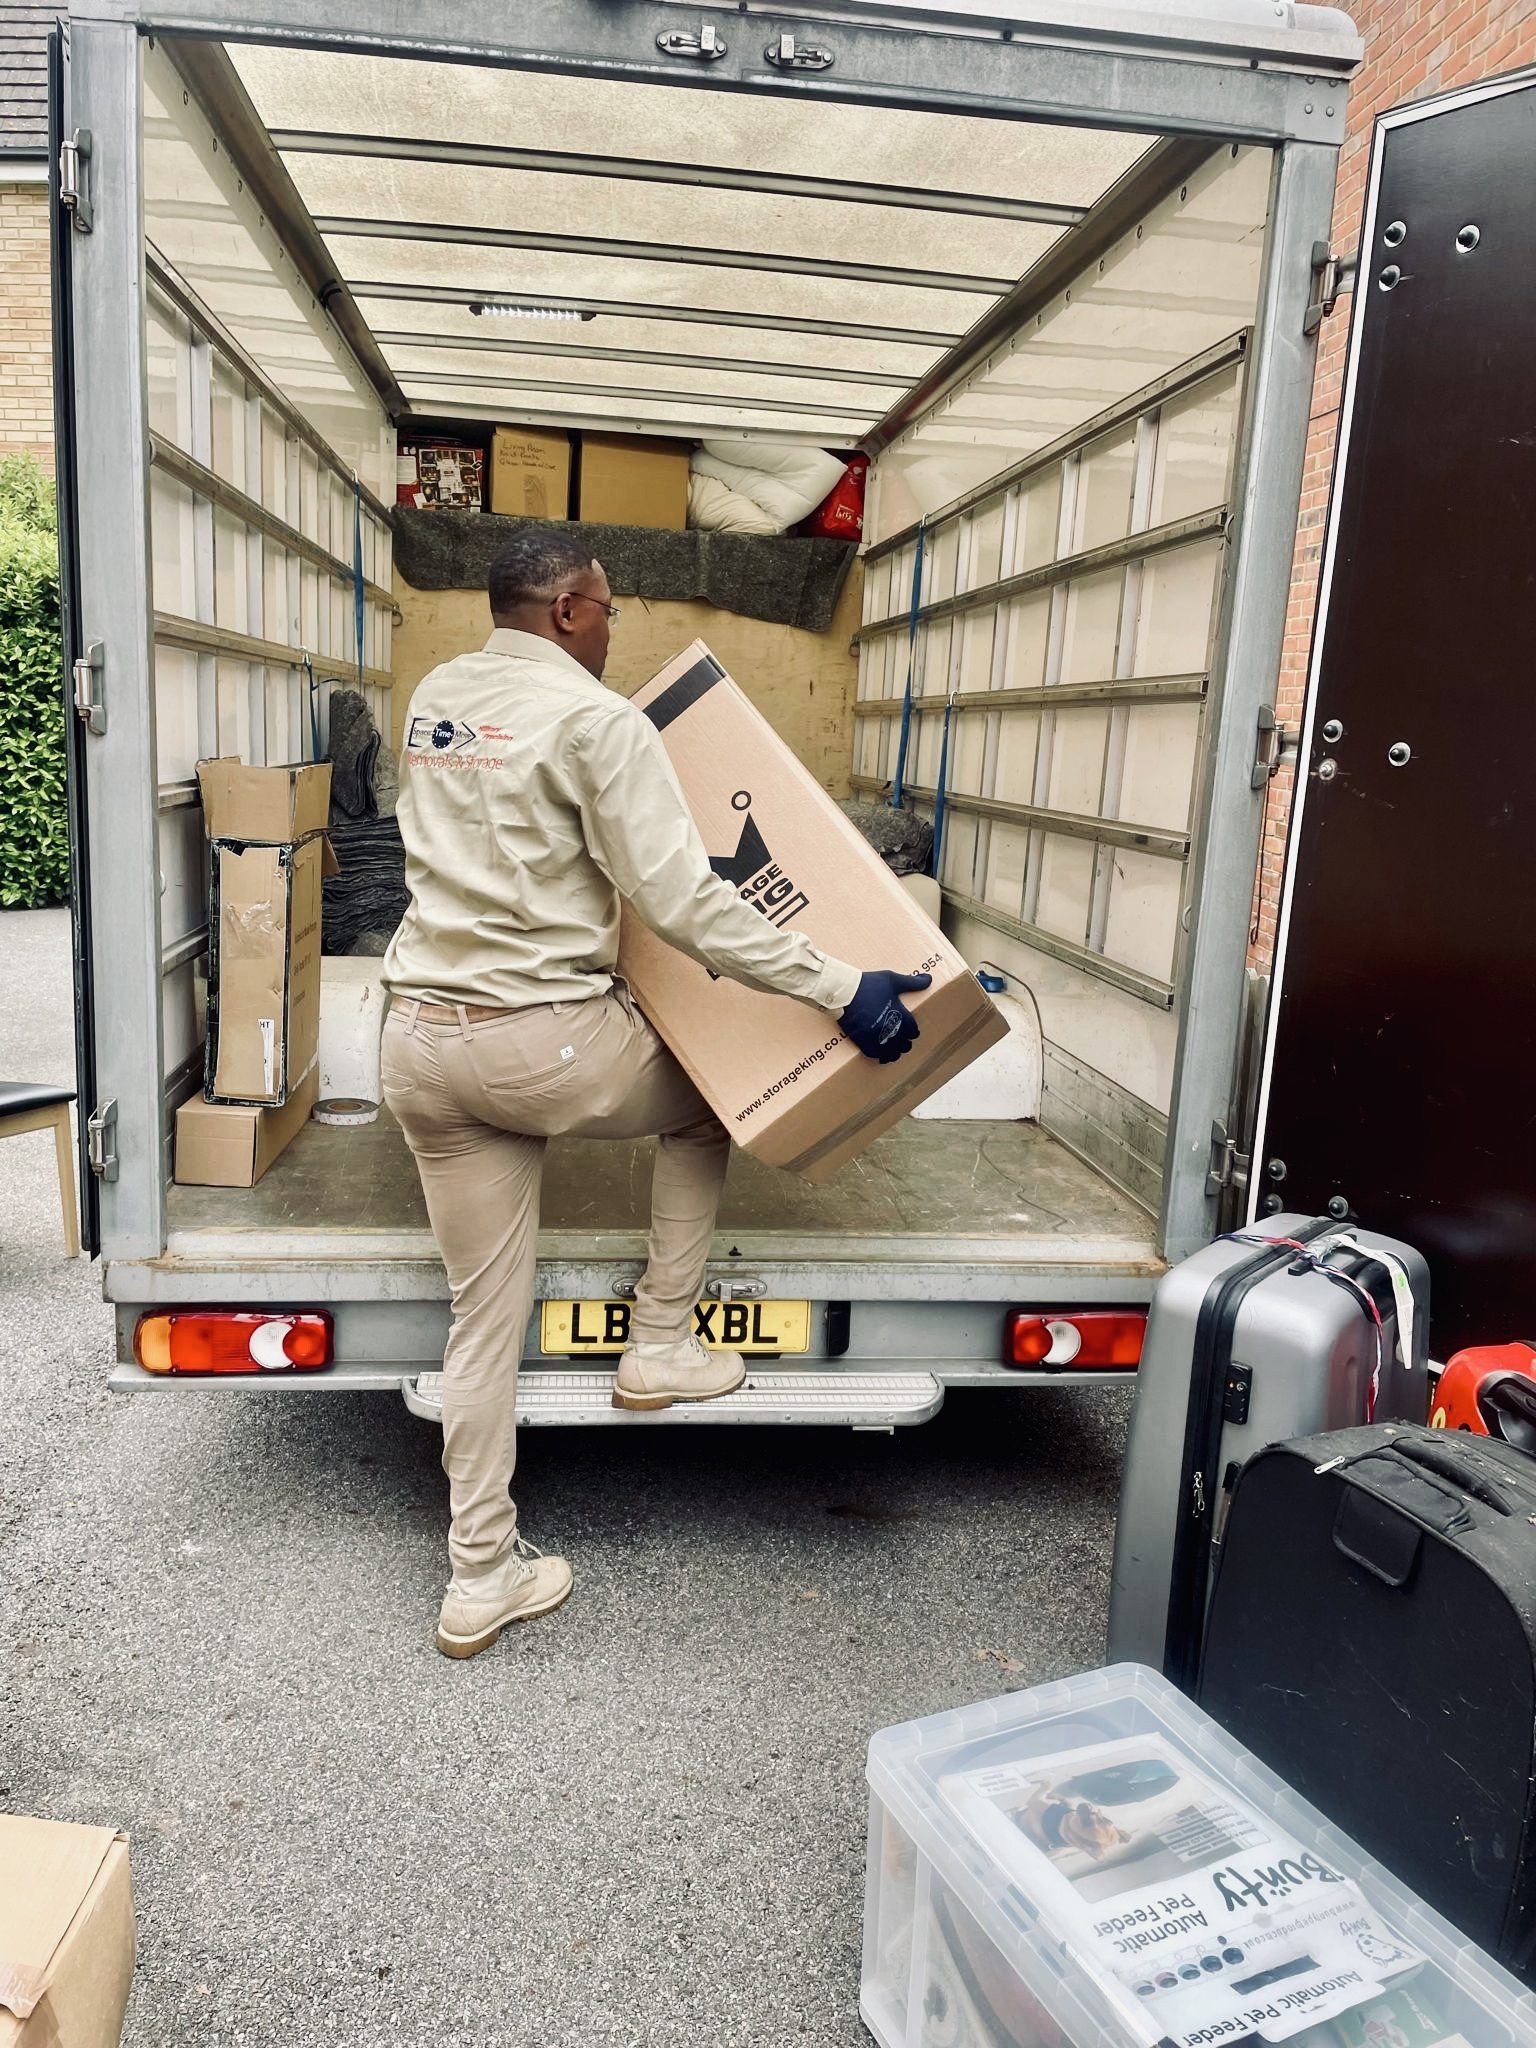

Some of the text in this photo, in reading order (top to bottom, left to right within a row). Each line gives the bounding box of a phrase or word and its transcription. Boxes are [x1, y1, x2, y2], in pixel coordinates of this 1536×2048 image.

[408, 751, 453, 768] Removals
[465, 755, 503, 772] Storage
[921, 952, 943, 972] 954
[735, 1031, 848, 1122] www.storageking.co.u
[571, 1303, 778, 1344] LB XBL
[1093, 1892, 1197, 1938] Pet Feeder
[1113, 1909, 1209, 1955] Automatic
[1182, 1970, 1364, 2048] Automatic Pet Feeder
